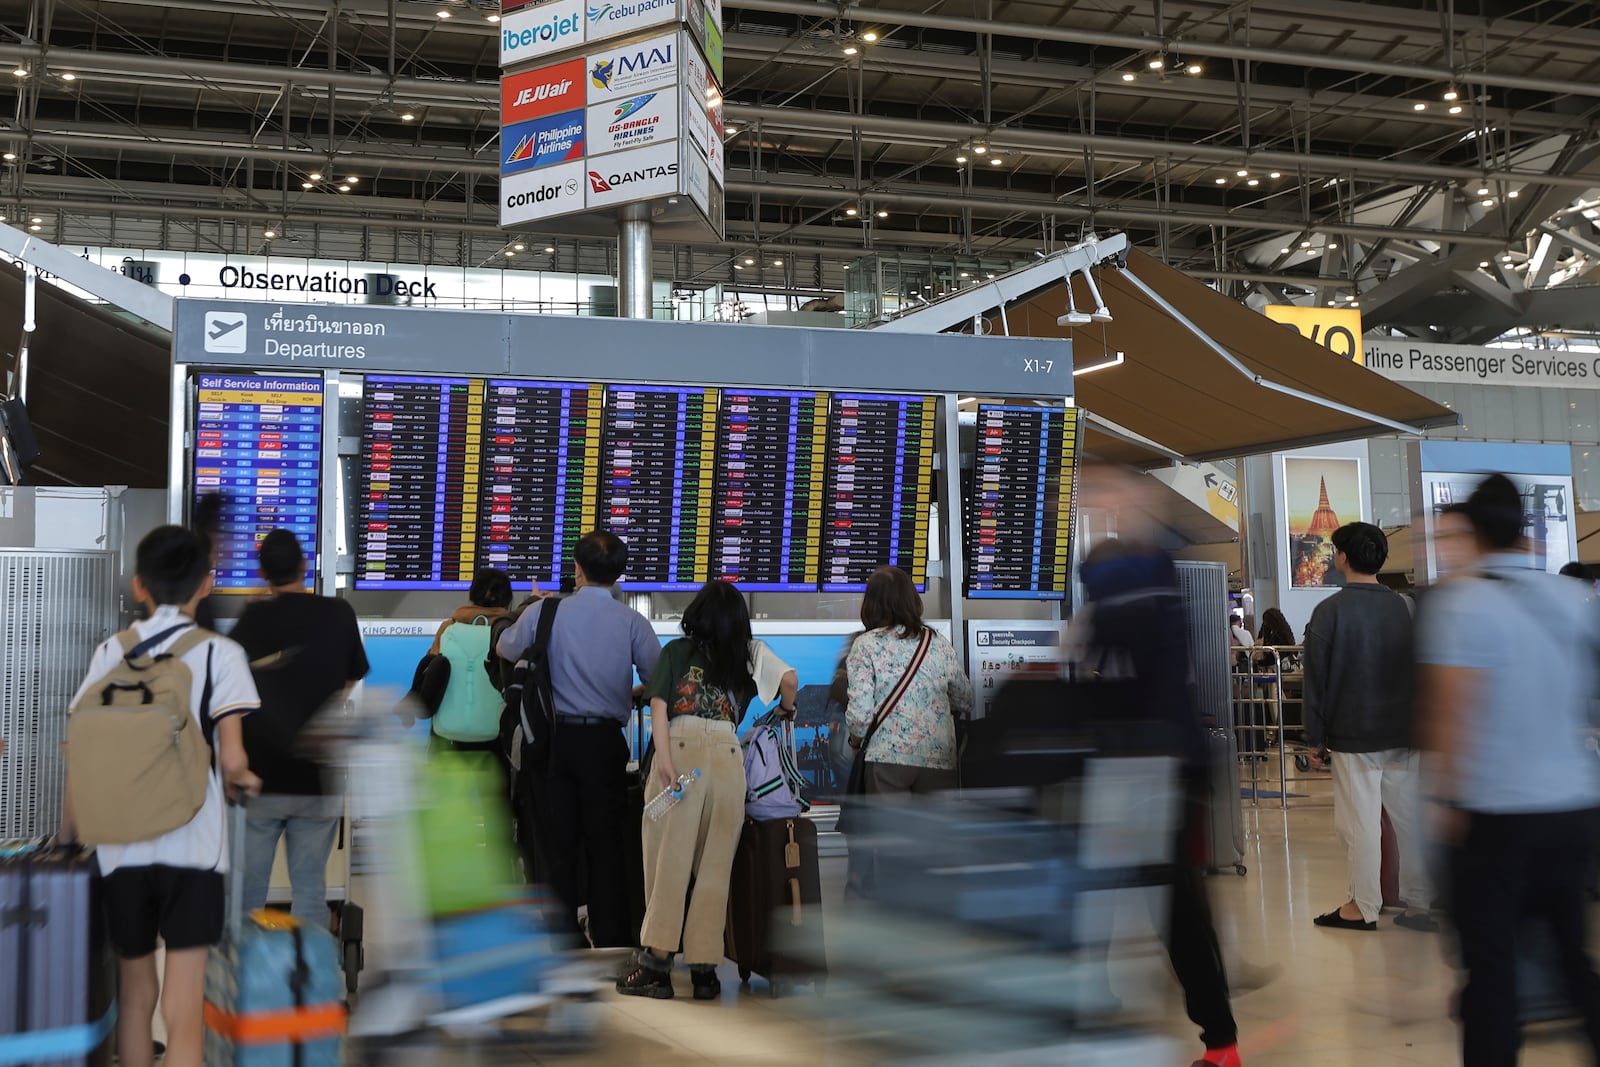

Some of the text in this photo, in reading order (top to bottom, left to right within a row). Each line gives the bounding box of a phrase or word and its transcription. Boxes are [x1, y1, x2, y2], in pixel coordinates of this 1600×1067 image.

[609, 4, 635, 20] cebu
[503, 12, 579, 51] iberojet
[617, 44, 671, 75] MAI
[512, 79, 573, 107] JEJUair
[538, 124, 583, 143] Philippine
[613, 126, 654, 141] AIRLINES
[536, 138, 572, 156] Airlines
[608, 163, 678, 186] QANTAS
[507, 184, 562, 208] condor
[219, 266, 438, 299] Observation Deck
[264, 308, 386, 337] เที่ยวบินขาออก
[265, 339, 366, 361] Departures
[1023, 358, 1054, 374] X1-7
[1409, 349, 1506, 378] Passenger
[1511, 354, 1588, 377] Services
[202, 378, 320, 391] Self Service Information
[362, 626, 423, 634] KING POWER
